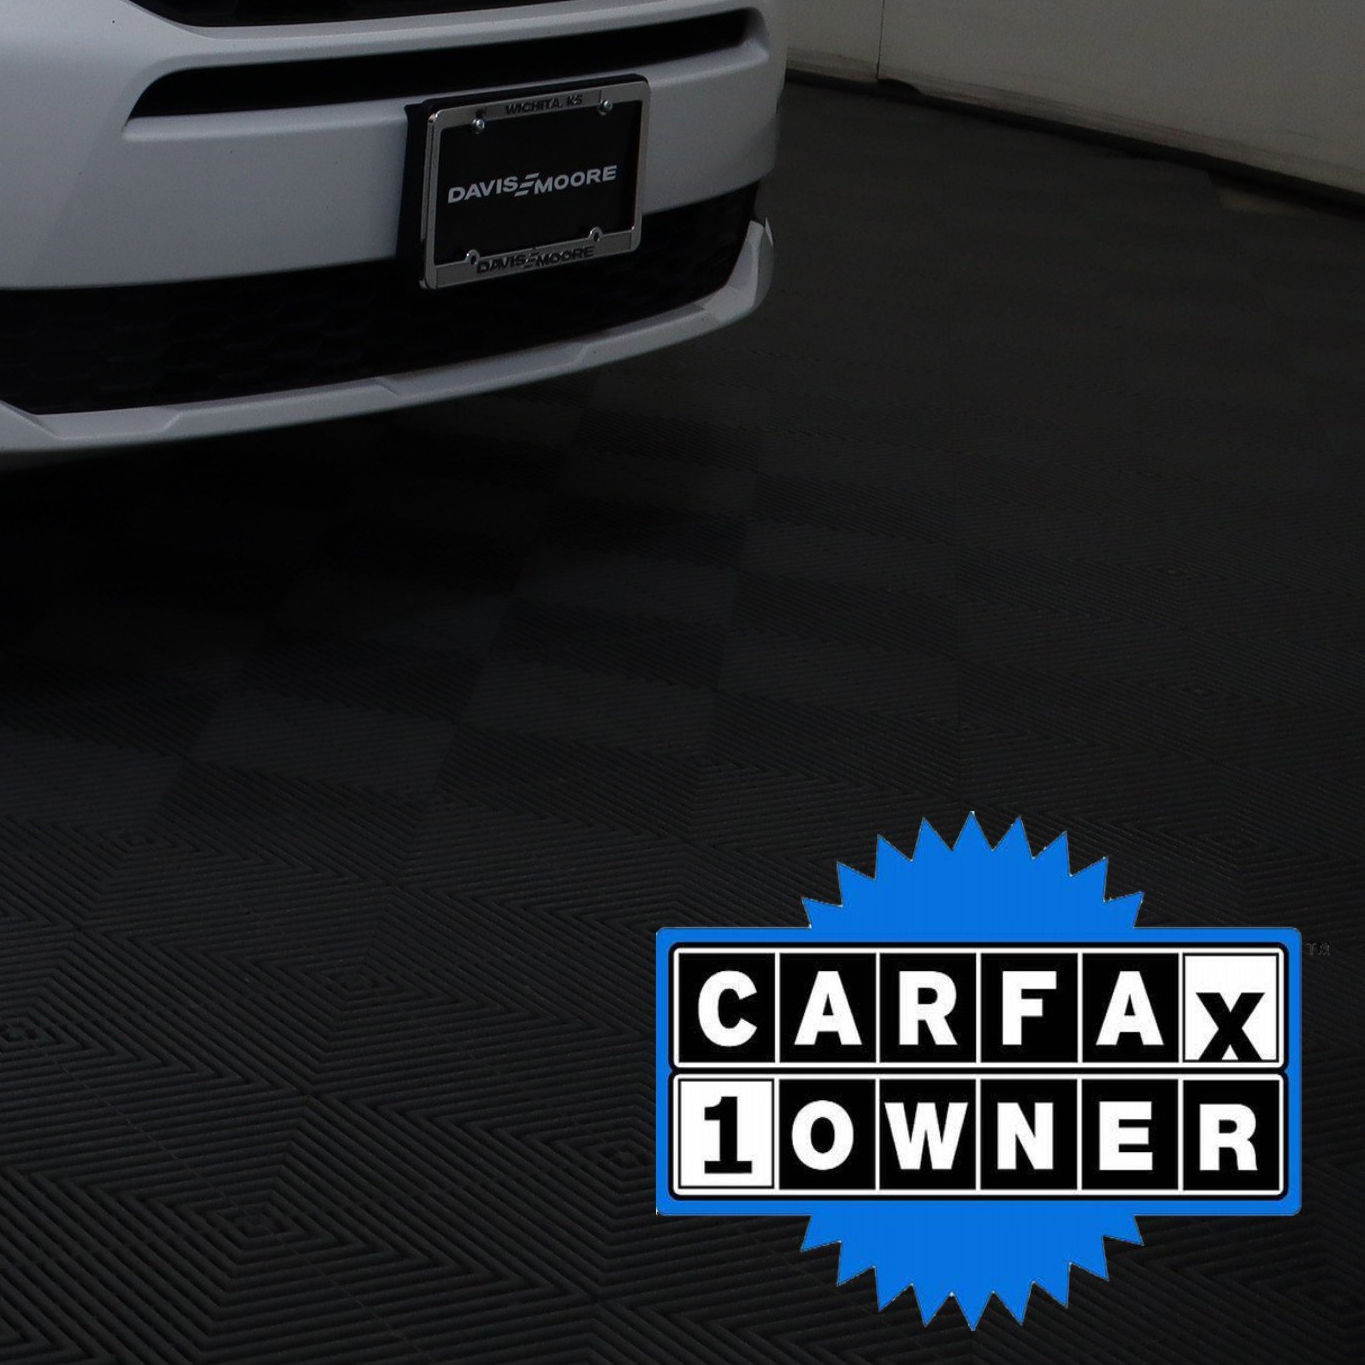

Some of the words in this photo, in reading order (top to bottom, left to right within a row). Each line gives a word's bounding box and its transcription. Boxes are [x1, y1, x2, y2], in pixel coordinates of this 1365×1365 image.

[447, 175, 519, 204] DAVIS
[533, 164, 618, 195] MOORE
[476, 254, 527, 274] DAVIS
[534, 245, 595, 266] MOORE
